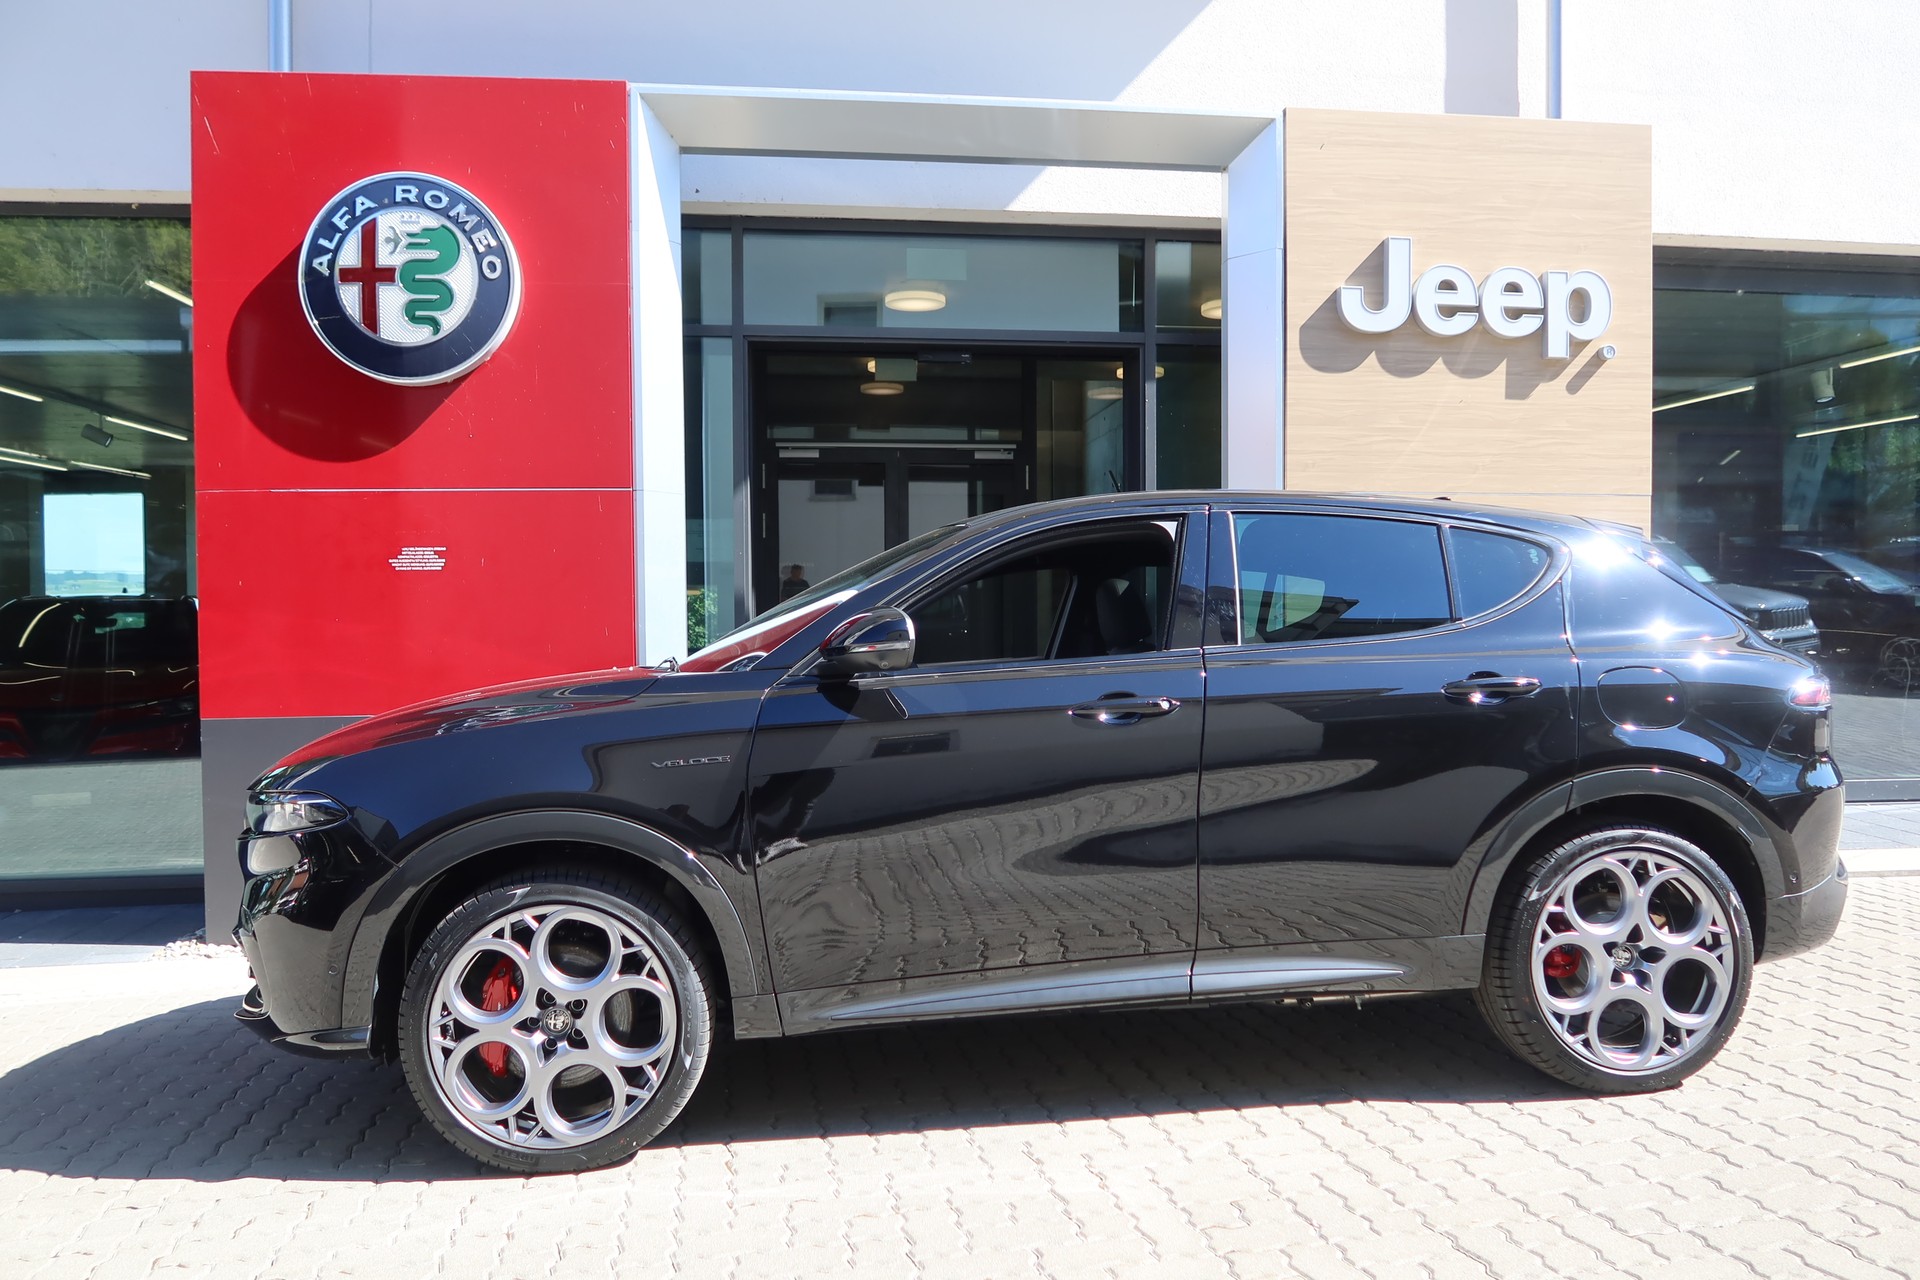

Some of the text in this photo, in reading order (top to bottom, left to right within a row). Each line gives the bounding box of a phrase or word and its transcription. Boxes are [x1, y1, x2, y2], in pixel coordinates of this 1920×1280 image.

[312, 185, 502, 280] ALFA ROMEO
[1337, 236, 1613, 359] Jeep
[651, 755, 731, 768] VELOCE
